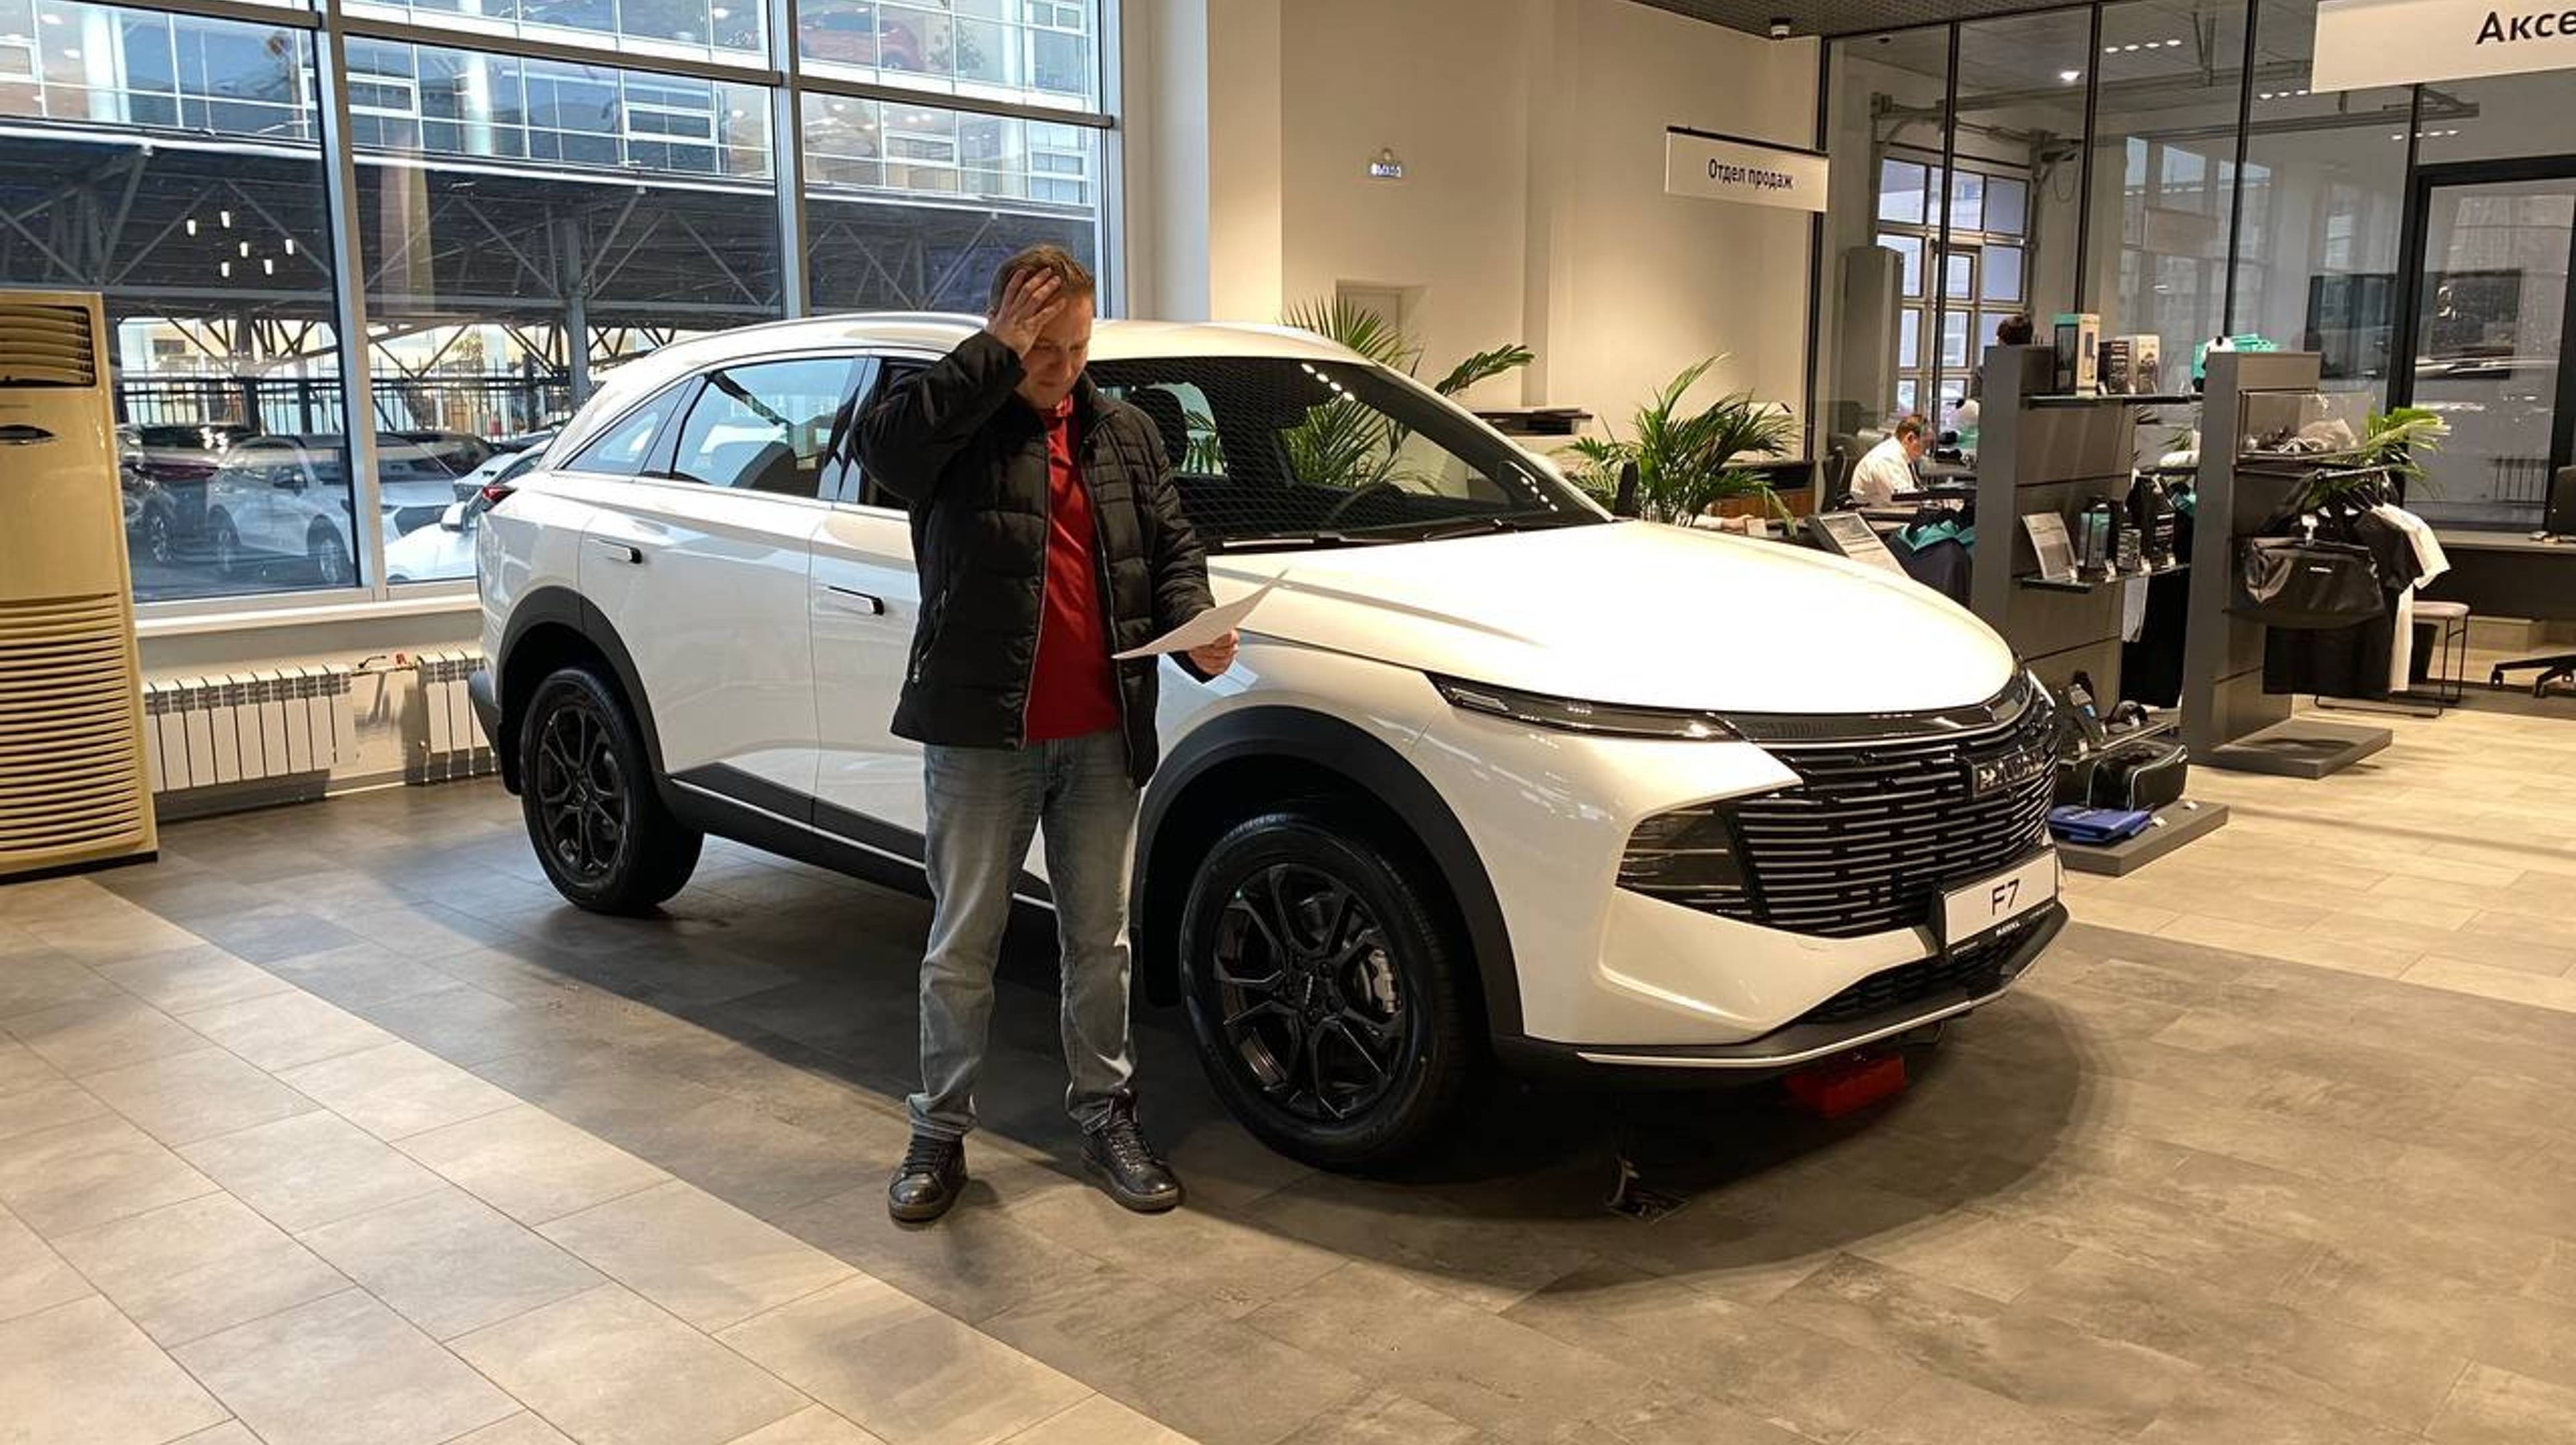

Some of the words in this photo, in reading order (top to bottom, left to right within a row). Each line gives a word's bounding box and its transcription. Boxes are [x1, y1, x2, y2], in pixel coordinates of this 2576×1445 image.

[1709, 158, 1746, 184] Отдел
[1748, 168, 1793, 189] продаж
[1992, 877, 2020, 916] F7
